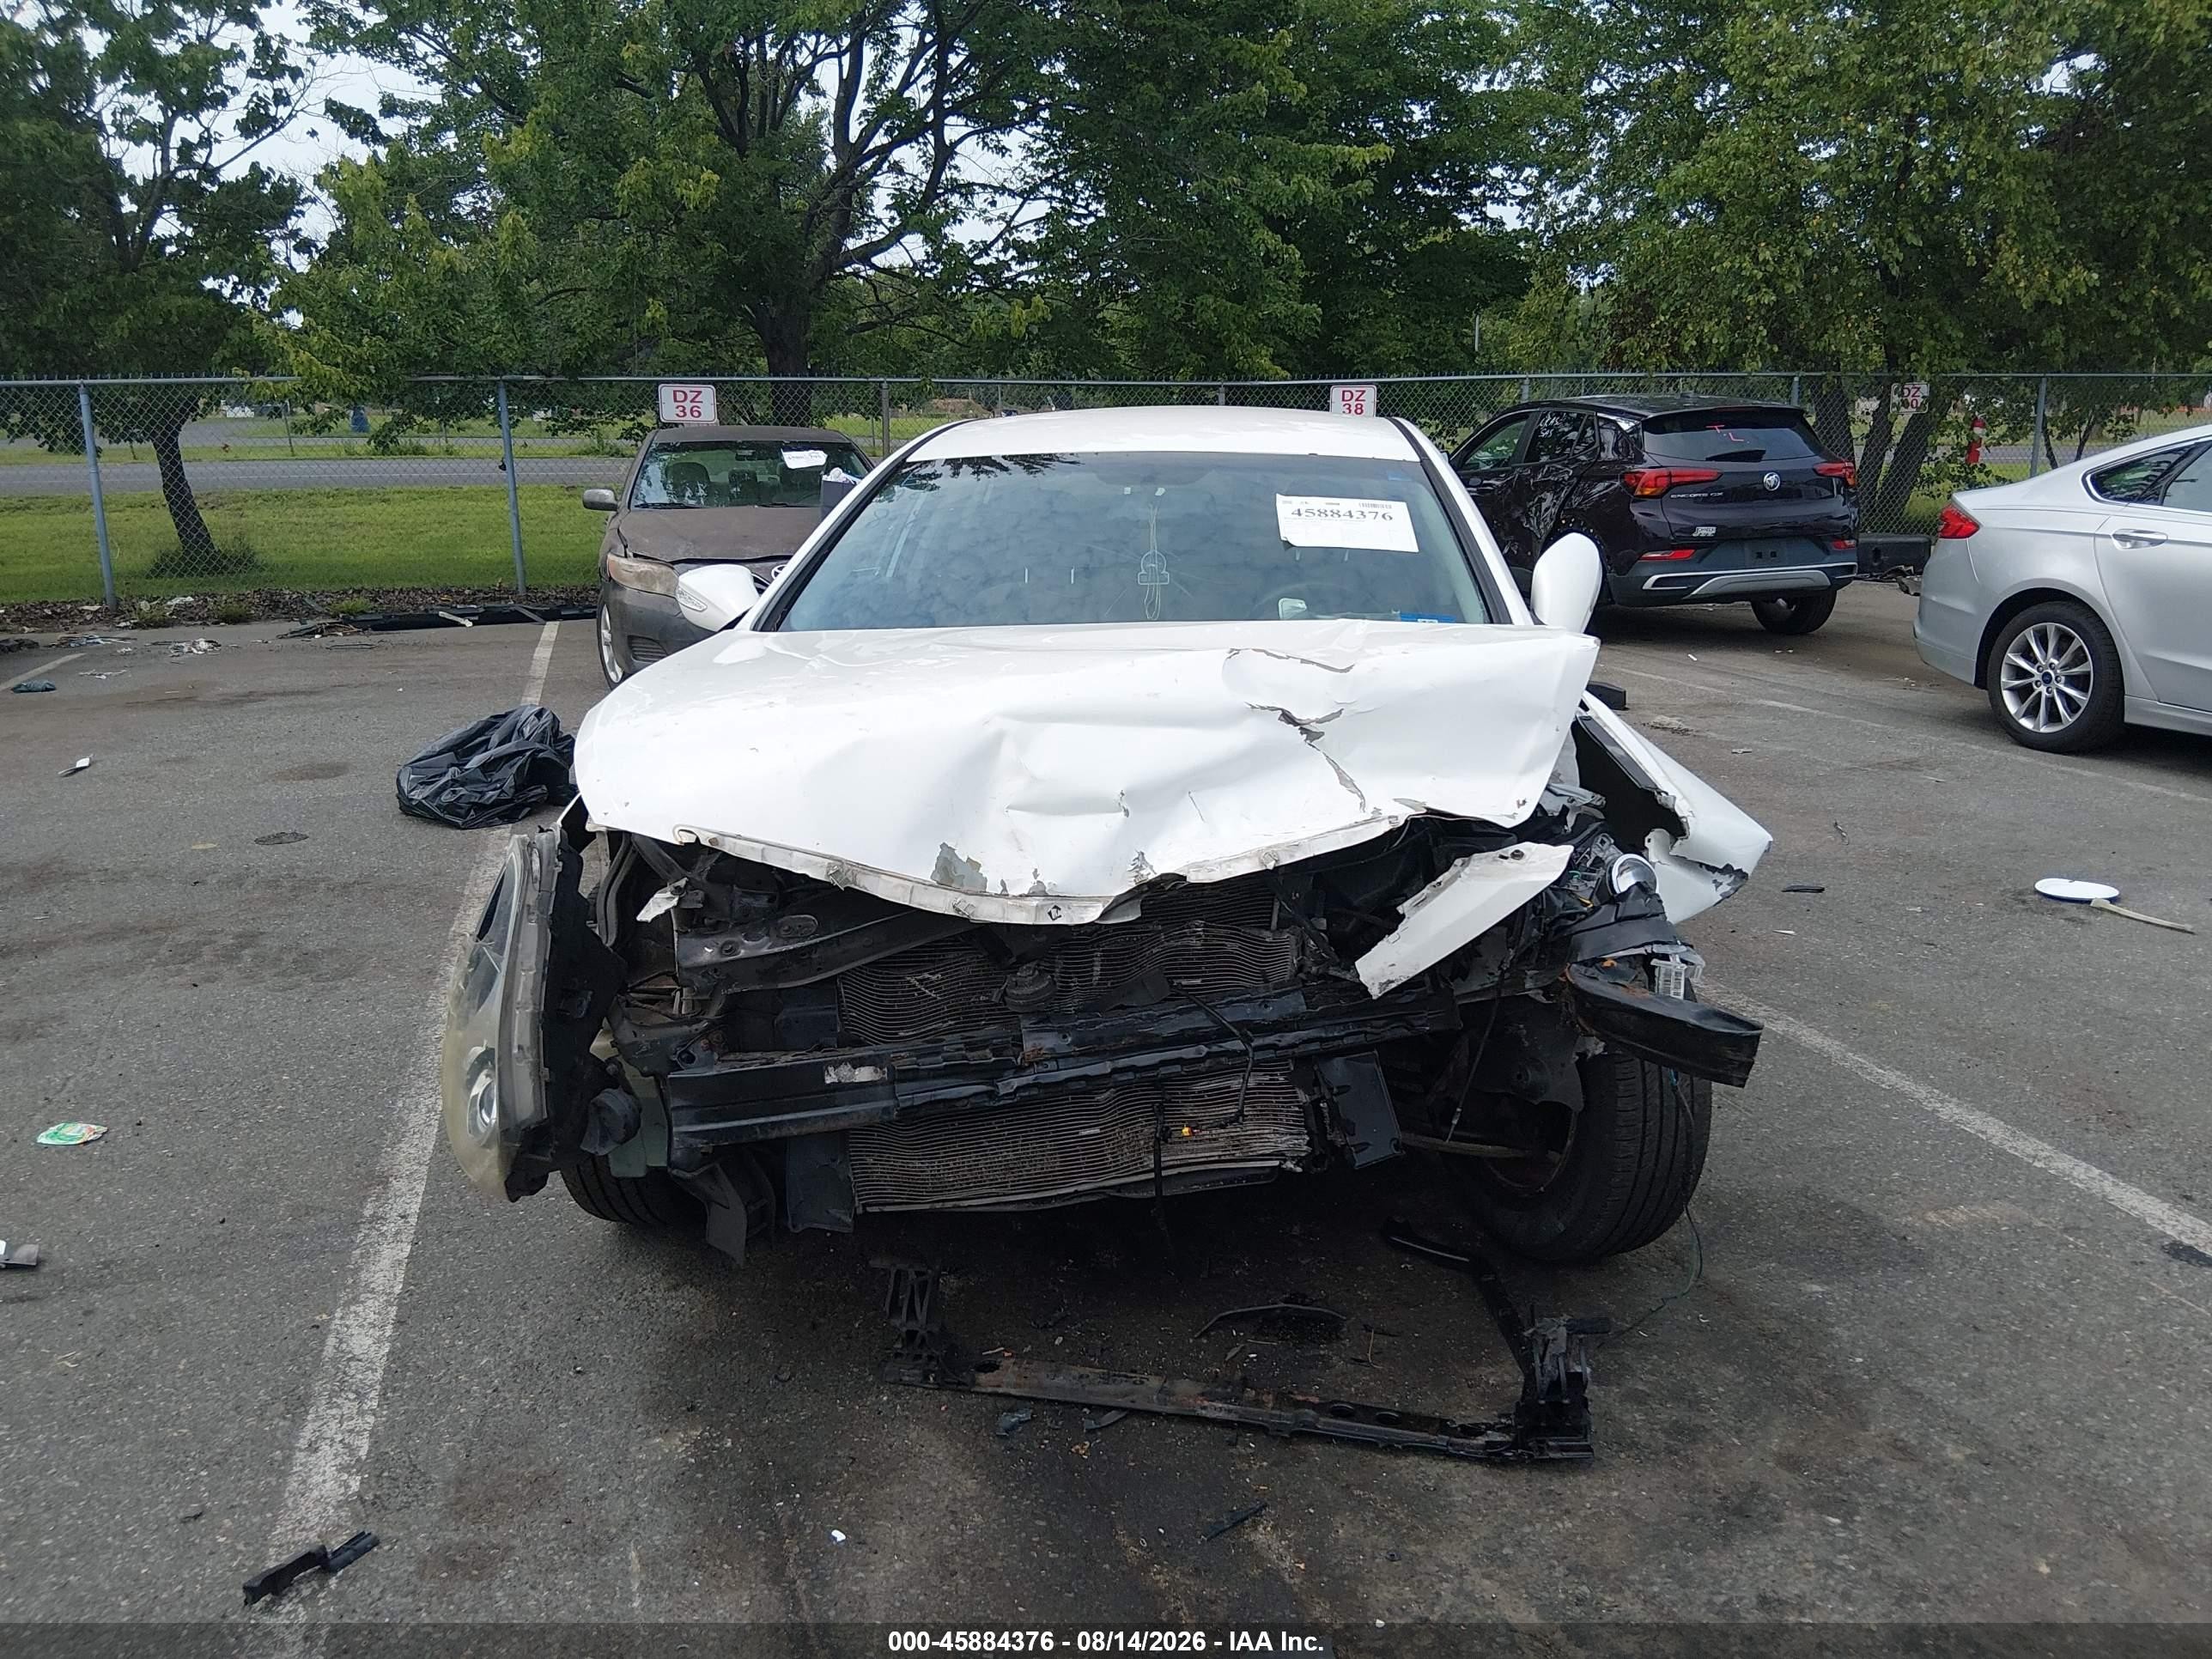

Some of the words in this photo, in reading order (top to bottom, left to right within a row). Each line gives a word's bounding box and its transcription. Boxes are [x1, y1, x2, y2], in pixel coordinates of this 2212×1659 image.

[672, 389, 703, 404] DZ
[1341, 390, 1367, 402] DZ
[1901, 386, 1921, 398] DZ
[675, 404, 702, 418] 36
[1342, 403, 1364, 416] 38
[1291, 507, 1394, 522] 45884376
